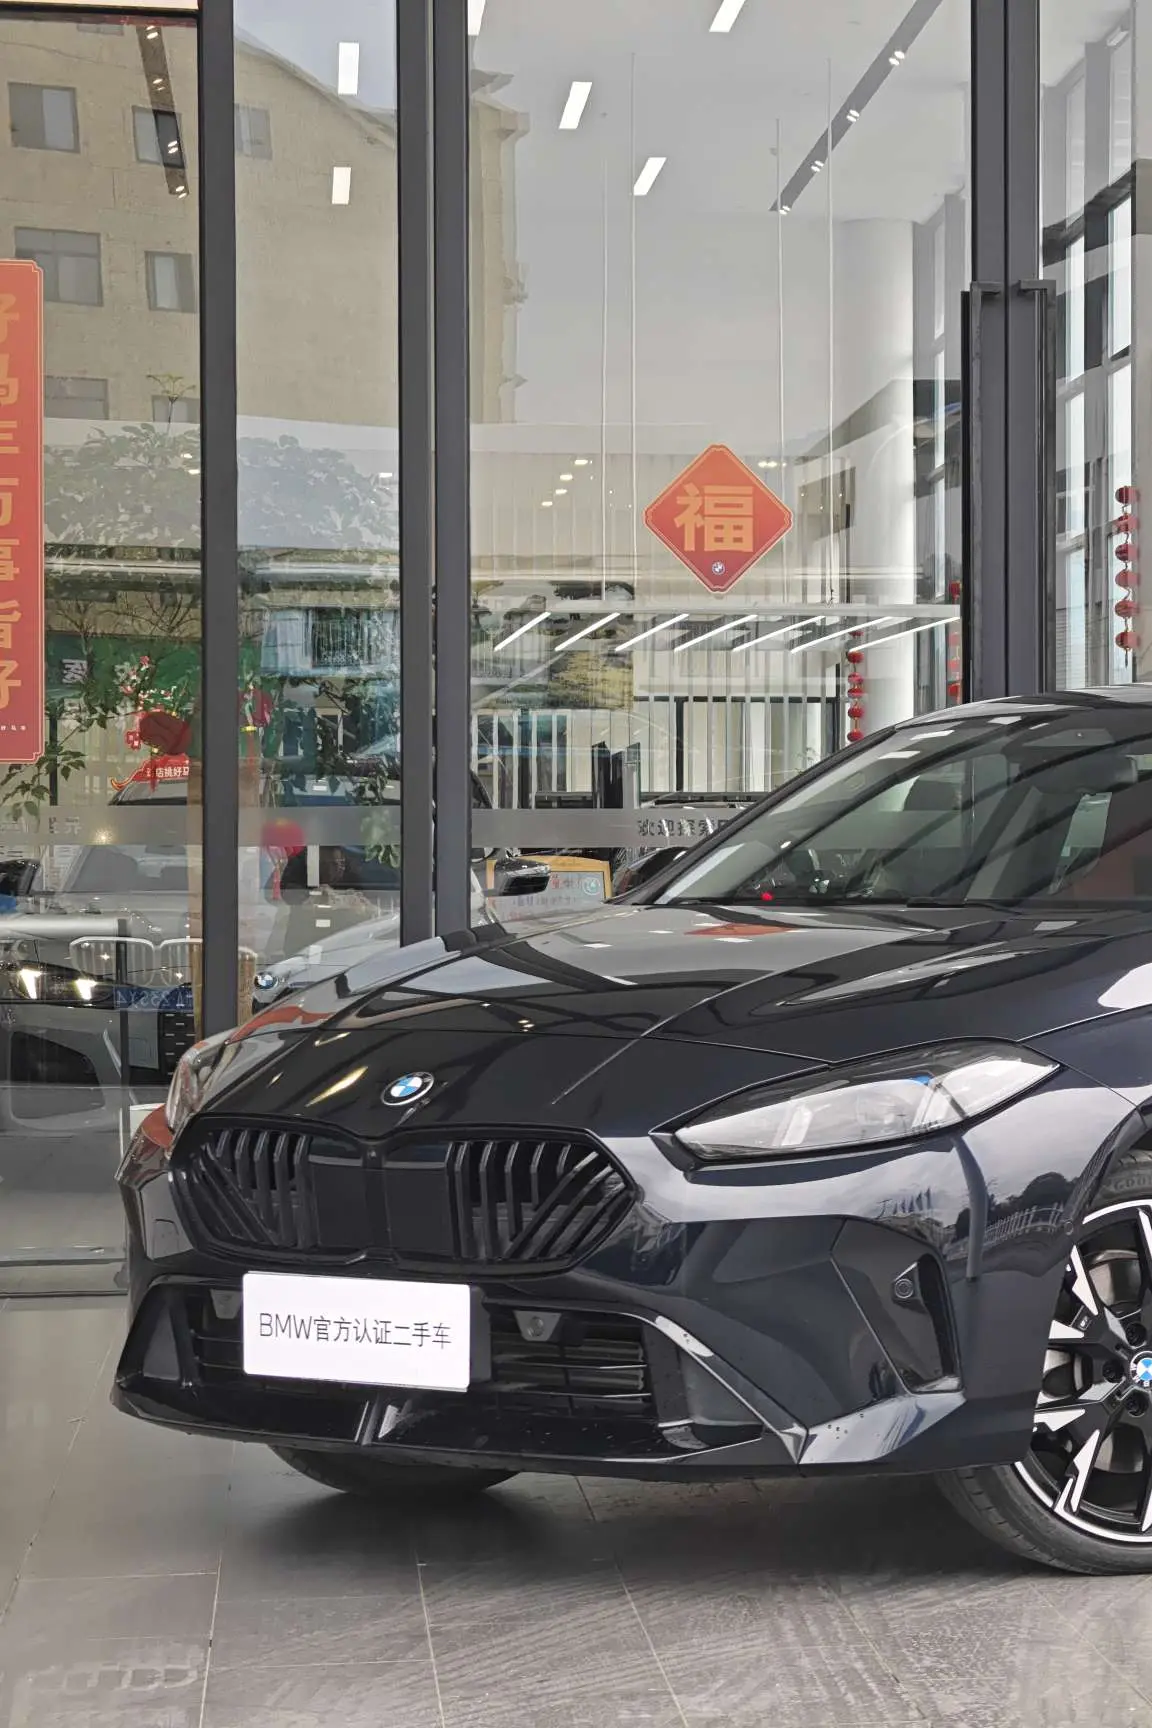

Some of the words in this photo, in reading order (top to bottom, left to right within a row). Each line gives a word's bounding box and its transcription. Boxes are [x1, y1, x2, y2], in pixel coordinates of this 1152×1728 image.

[673, 483, 754, 552] 福
[259, 1313, 452, 1349] BMW官方认证二手车
